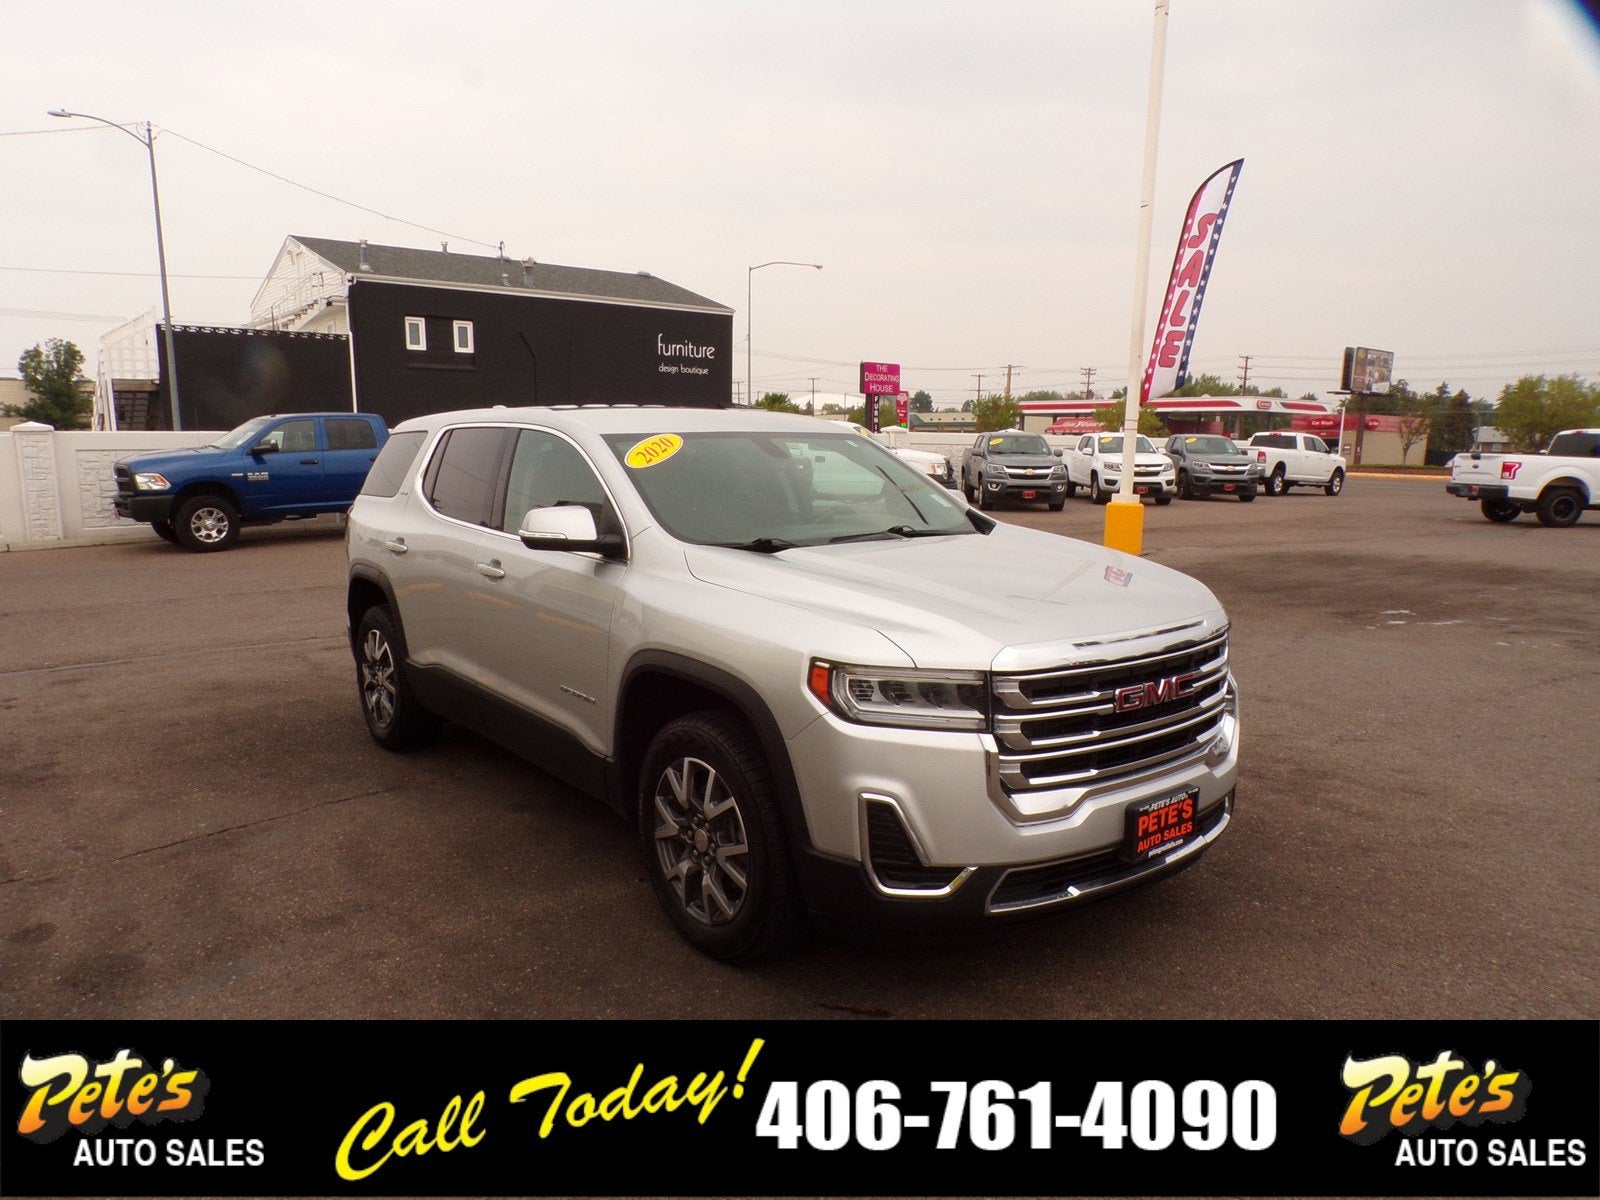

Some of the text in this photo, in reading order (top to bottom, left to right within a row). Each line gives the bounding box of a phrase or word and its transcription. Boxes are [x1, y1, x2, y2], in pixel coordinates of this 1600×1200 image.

[1158, 213, 1217, 368] SALE
[657, 333, 715, 359] furniture
[658, 362, 709, 375] design boutique
[864, 372, 899, 382] DECORATING
[869, 383, 893, 393] HOUSE
[636, 437, 675, 464] 2020
[1115, 673, 1195, 713] GMC
[1138, 798, 1193, 837] PETE'S
[1137, 833, 1162, 853] AUTO
[1163, 821, 1193, 841] SALES
